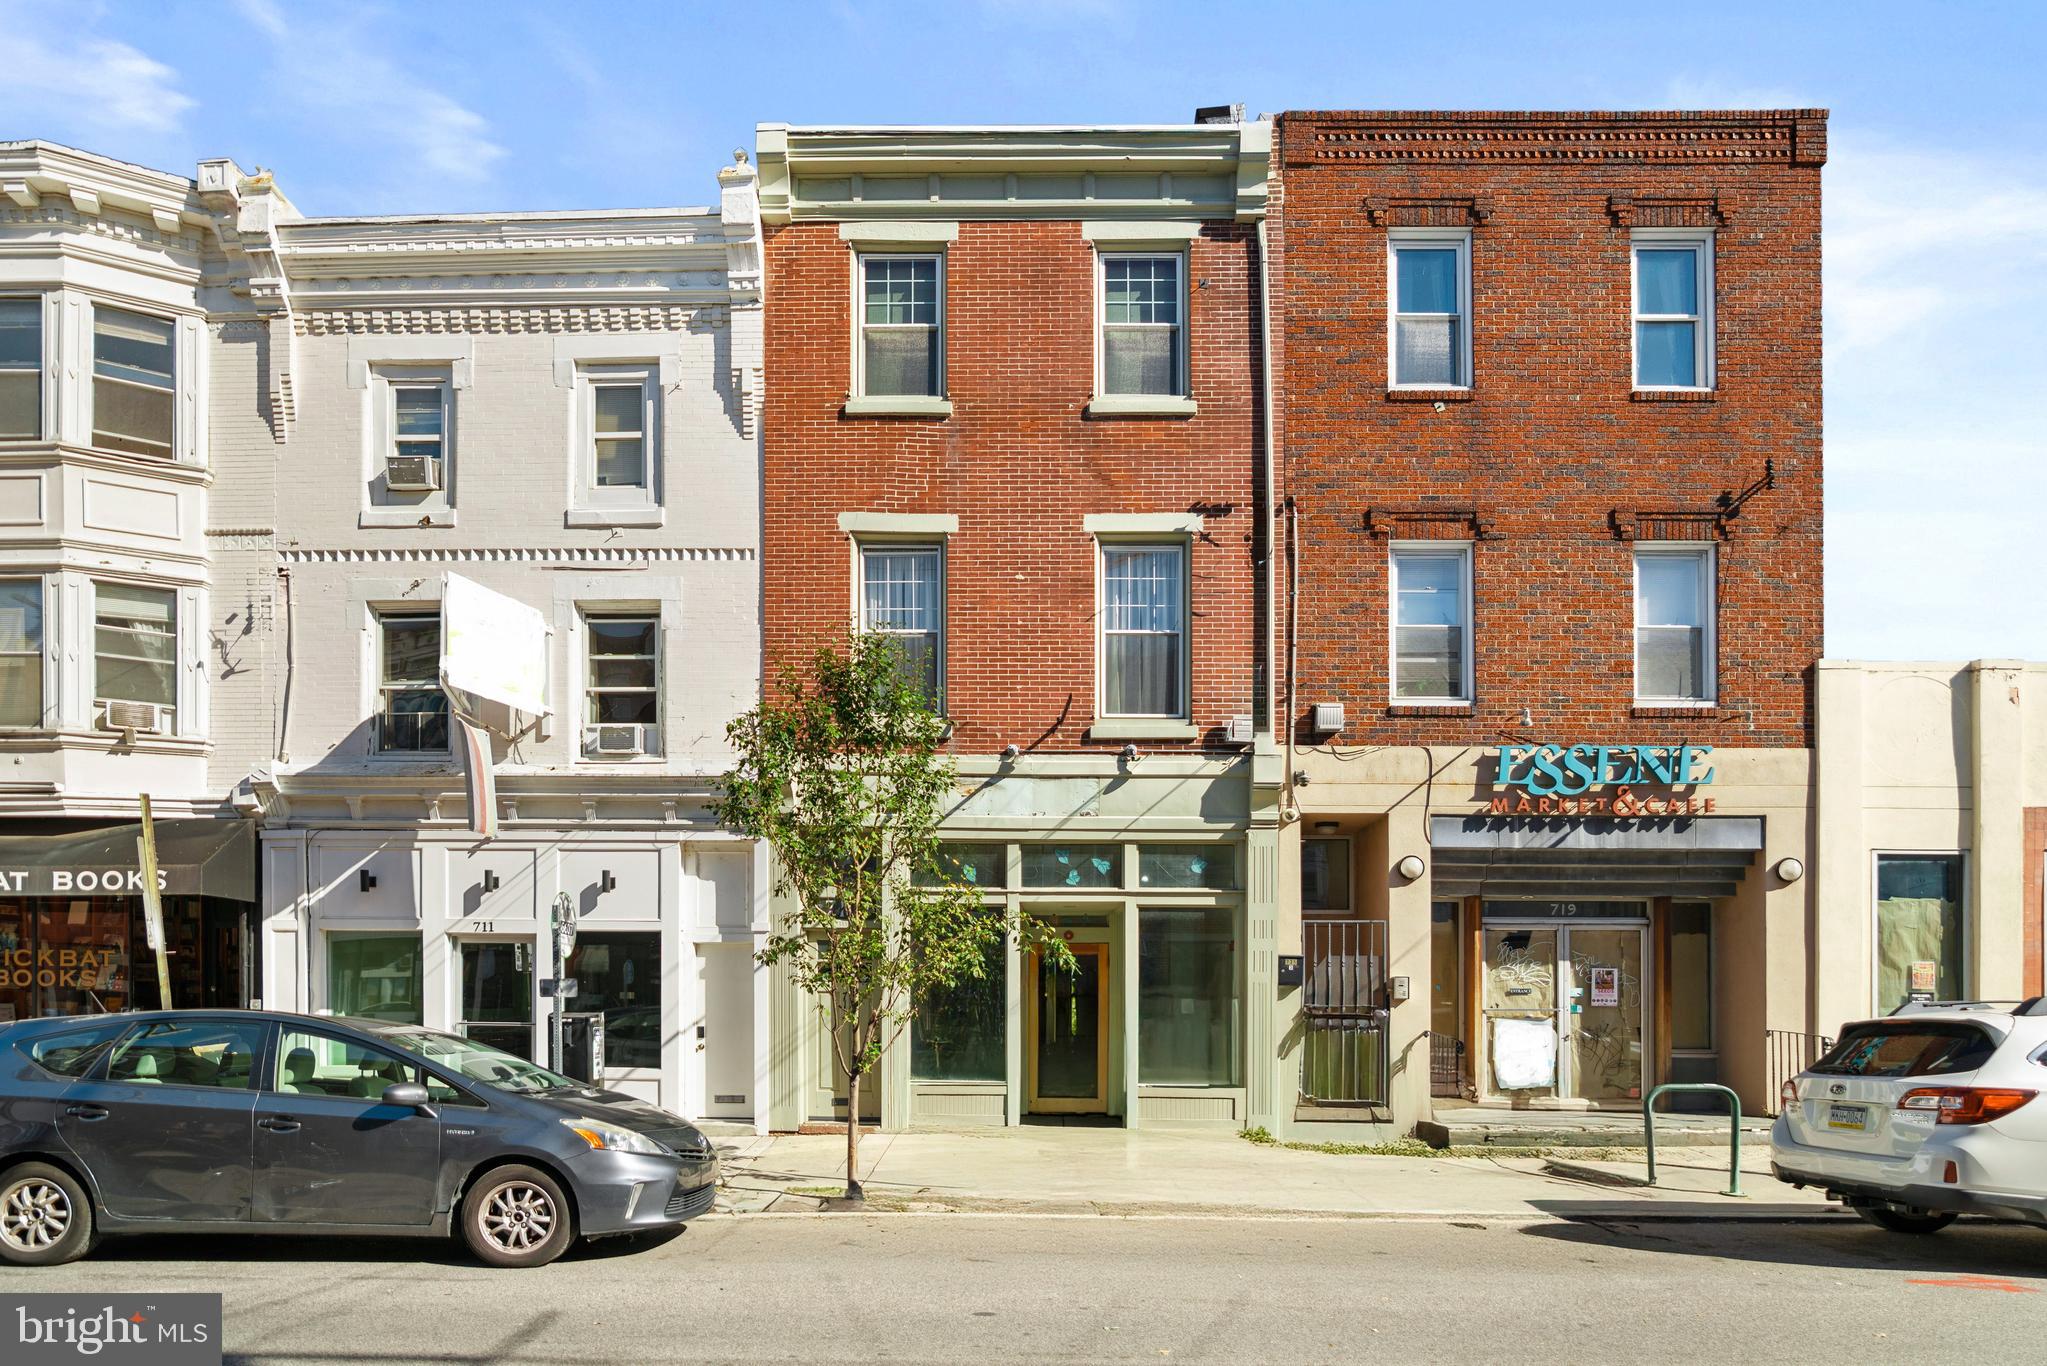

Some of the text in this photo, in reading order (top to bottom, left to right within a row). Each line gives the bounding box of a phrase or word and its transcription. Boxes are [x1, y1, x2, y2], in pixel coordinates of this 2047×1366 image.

[1492, 744, 1715, 795] ESSENE
[1490, 785, 1716, 816] MARKET & CAFE
[1551, 903, 1576, 916] 719
[473, 921, 494, 933] 711
